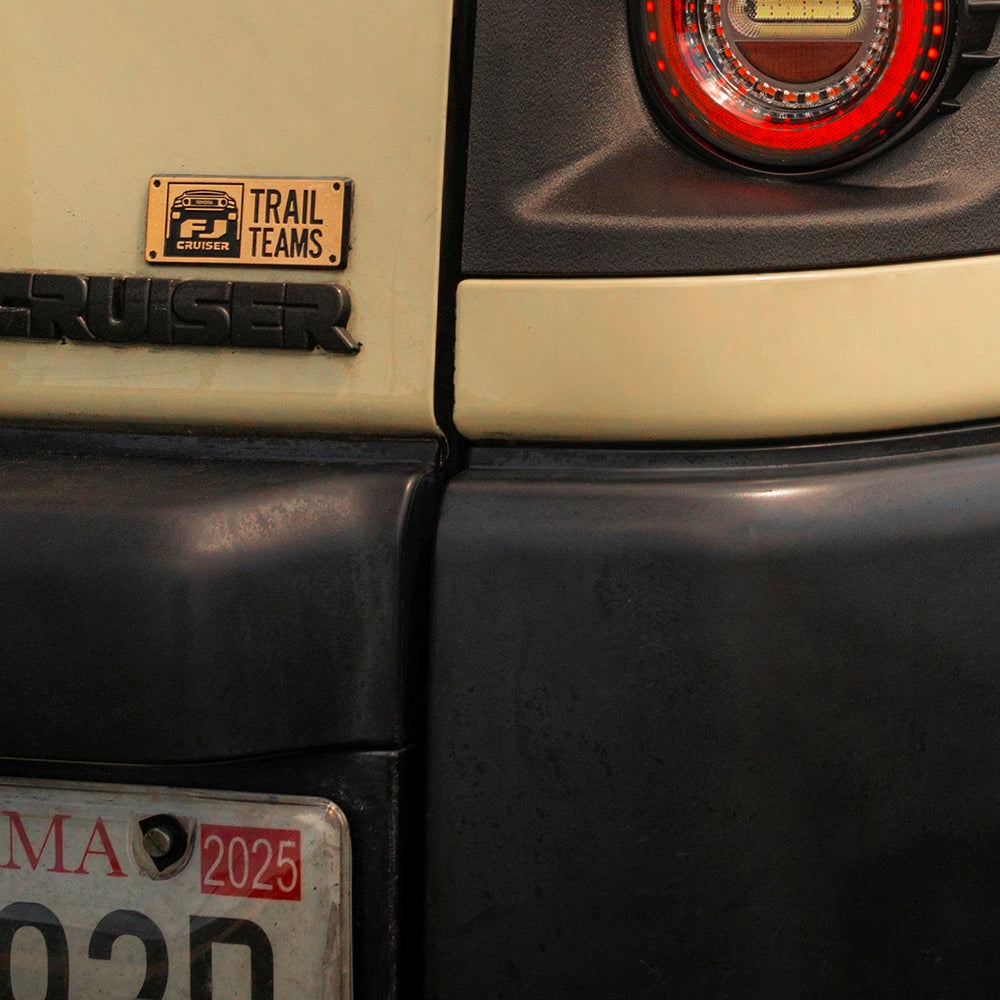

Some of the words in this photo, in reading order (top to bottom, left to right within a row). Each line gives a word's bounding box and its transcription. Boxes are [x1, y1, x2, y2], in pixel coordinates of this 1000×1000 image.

[250, 189, 323, 225] TRAIL
[176, 240, 230, 251] CRUISER
[180, 219, 227, 239] FJ
[249, 227, 323, 259] TEAMS
[0, 811, 128, 878] MA
[203, 834, 298, 893] 2025
